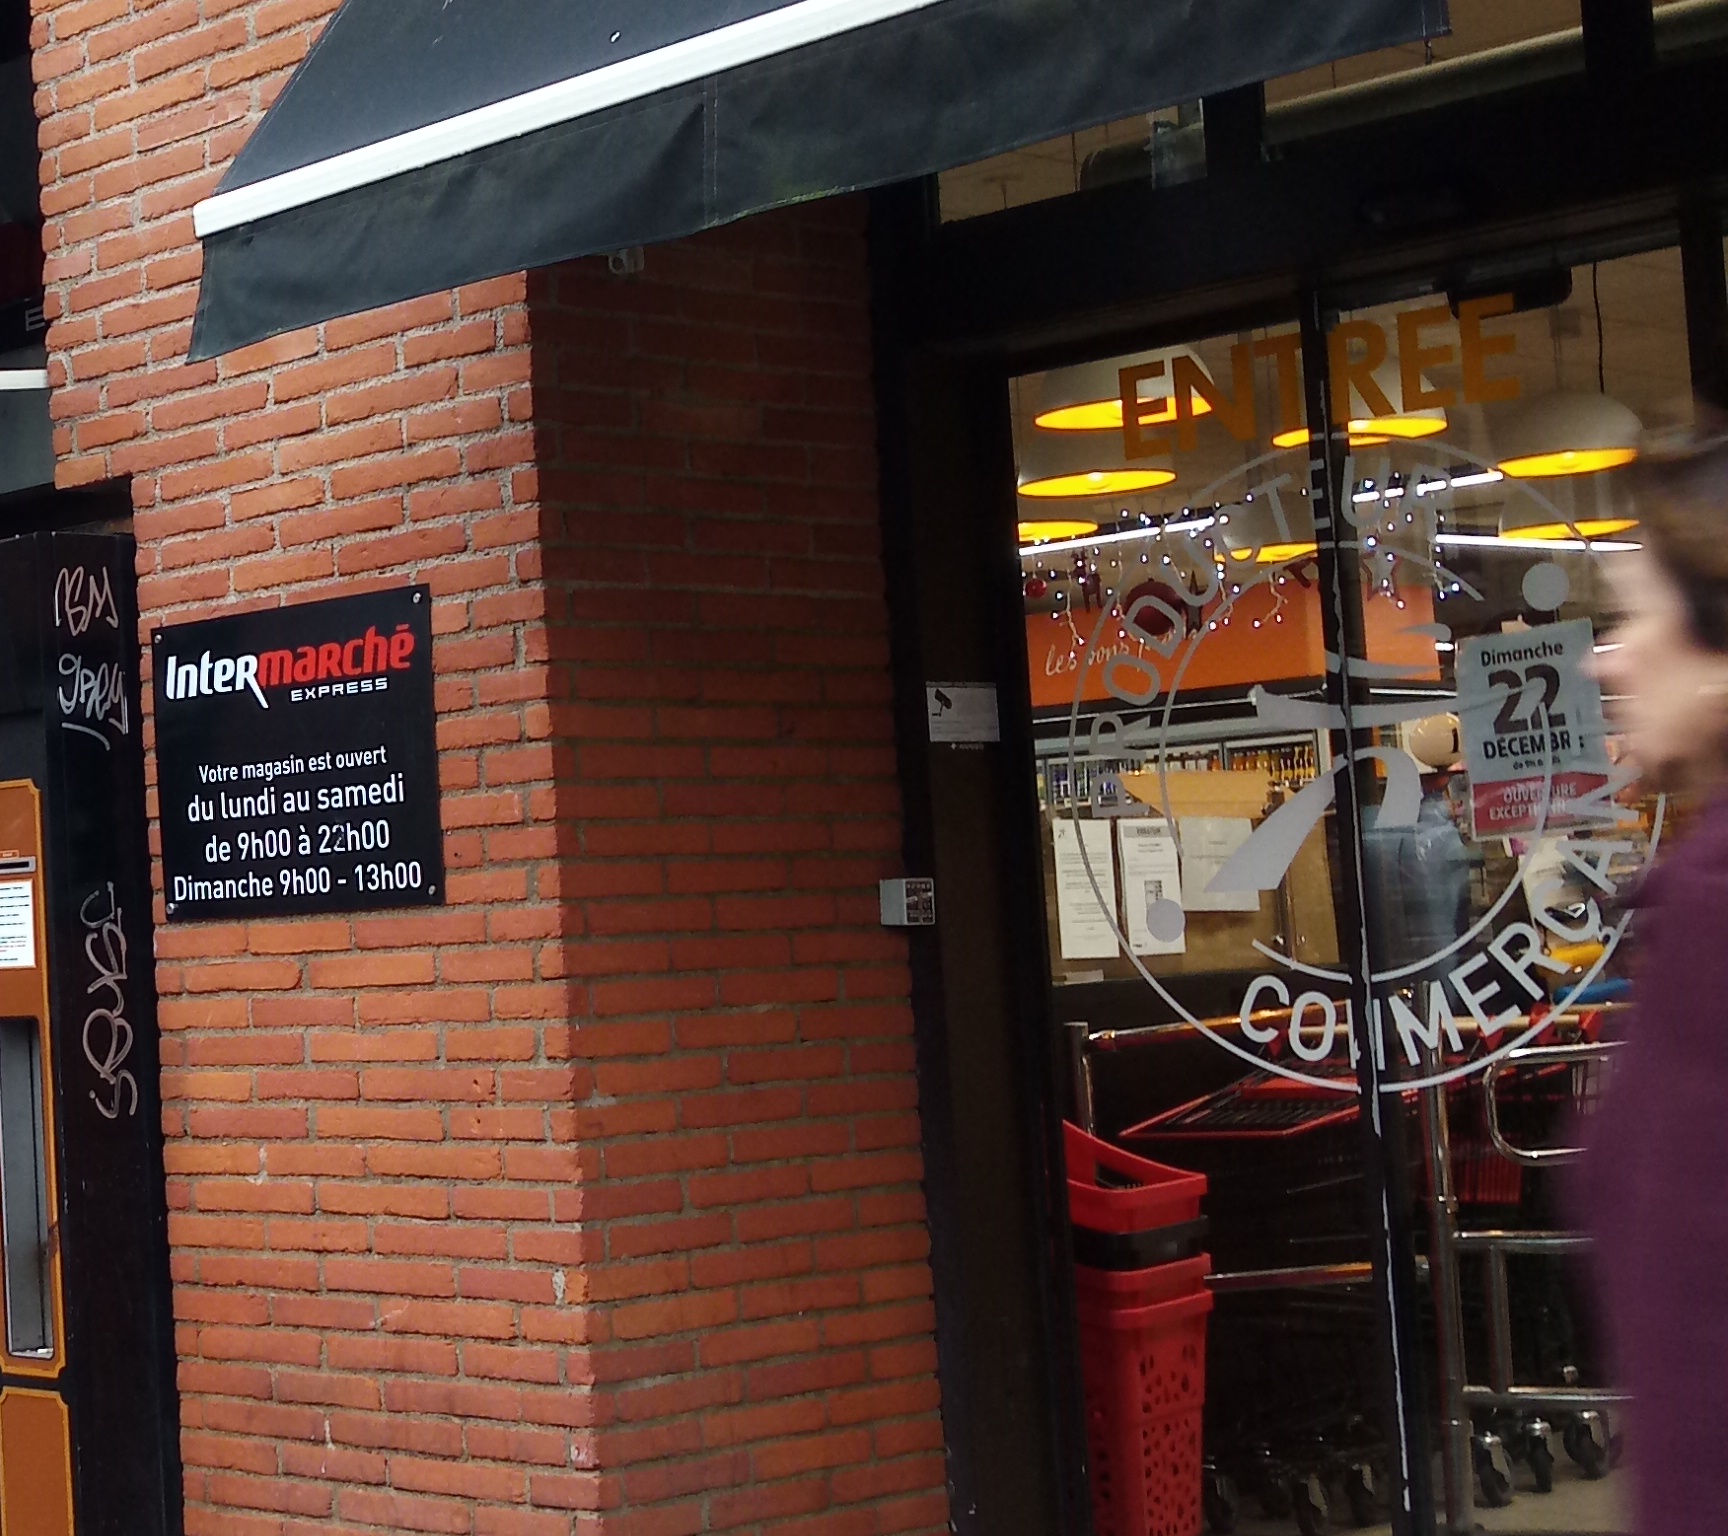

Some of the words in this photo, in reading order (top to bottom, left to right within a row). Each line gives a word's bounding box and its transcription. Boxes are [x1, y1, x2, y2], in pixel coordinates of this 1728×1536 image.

[1481, 641, 1564, 667] Dimanche
[291, 677, 388, 702] EXPRESS
[1488, 663, 1566, 734] 22
[199, 762, 238, 784] Votre
[242, 754, 304, 781] magasin
[308, 752, 332, 772] est
[336, 745, 387, 768] ouvert
[187, 795, 214, 822] du
[221, 787, 276, 819] lundi
[283, 791, 310, 813] au
[317, 773, 405, 810] samedi
[205, 835, 232, 863] de
[237, 829, 291, 860] 9h00
[298, 825, 311, 855] à
[318, 820, 390, 853] 22h00
[174, 871, 273, 901] Dimanche
[279, 867, 331, 896] 9h00
[354, 861, 421, 891] 13h00
